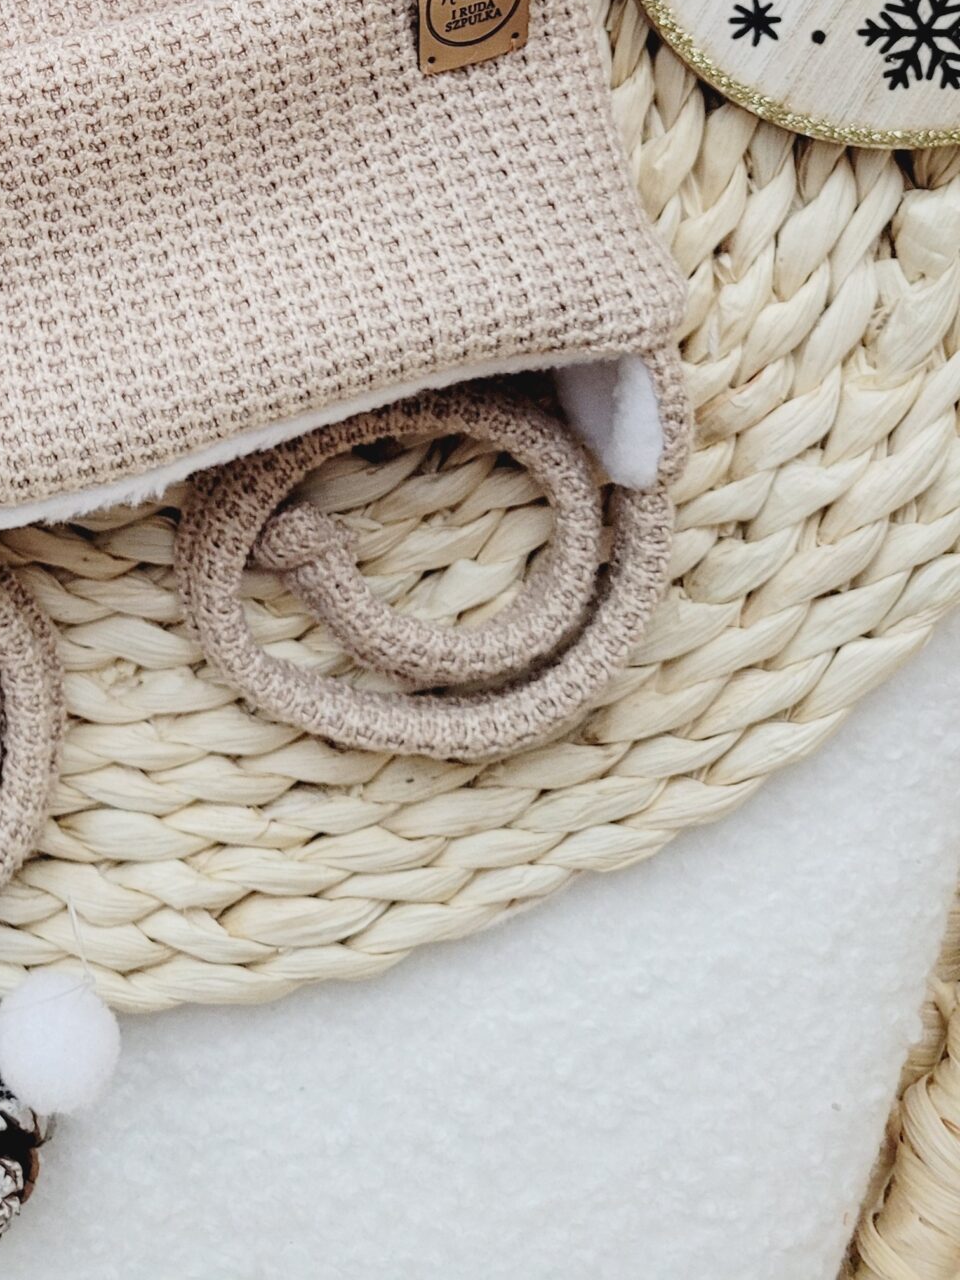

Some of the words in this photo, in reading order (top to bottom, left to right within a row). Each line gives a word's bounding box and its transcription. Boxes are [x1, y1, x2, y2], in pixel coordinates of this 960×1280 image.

[445, 7, 503, 32] SZPULKA
[451, 9, 457, 20] I
[459, 0, 496, 18] RUDA
